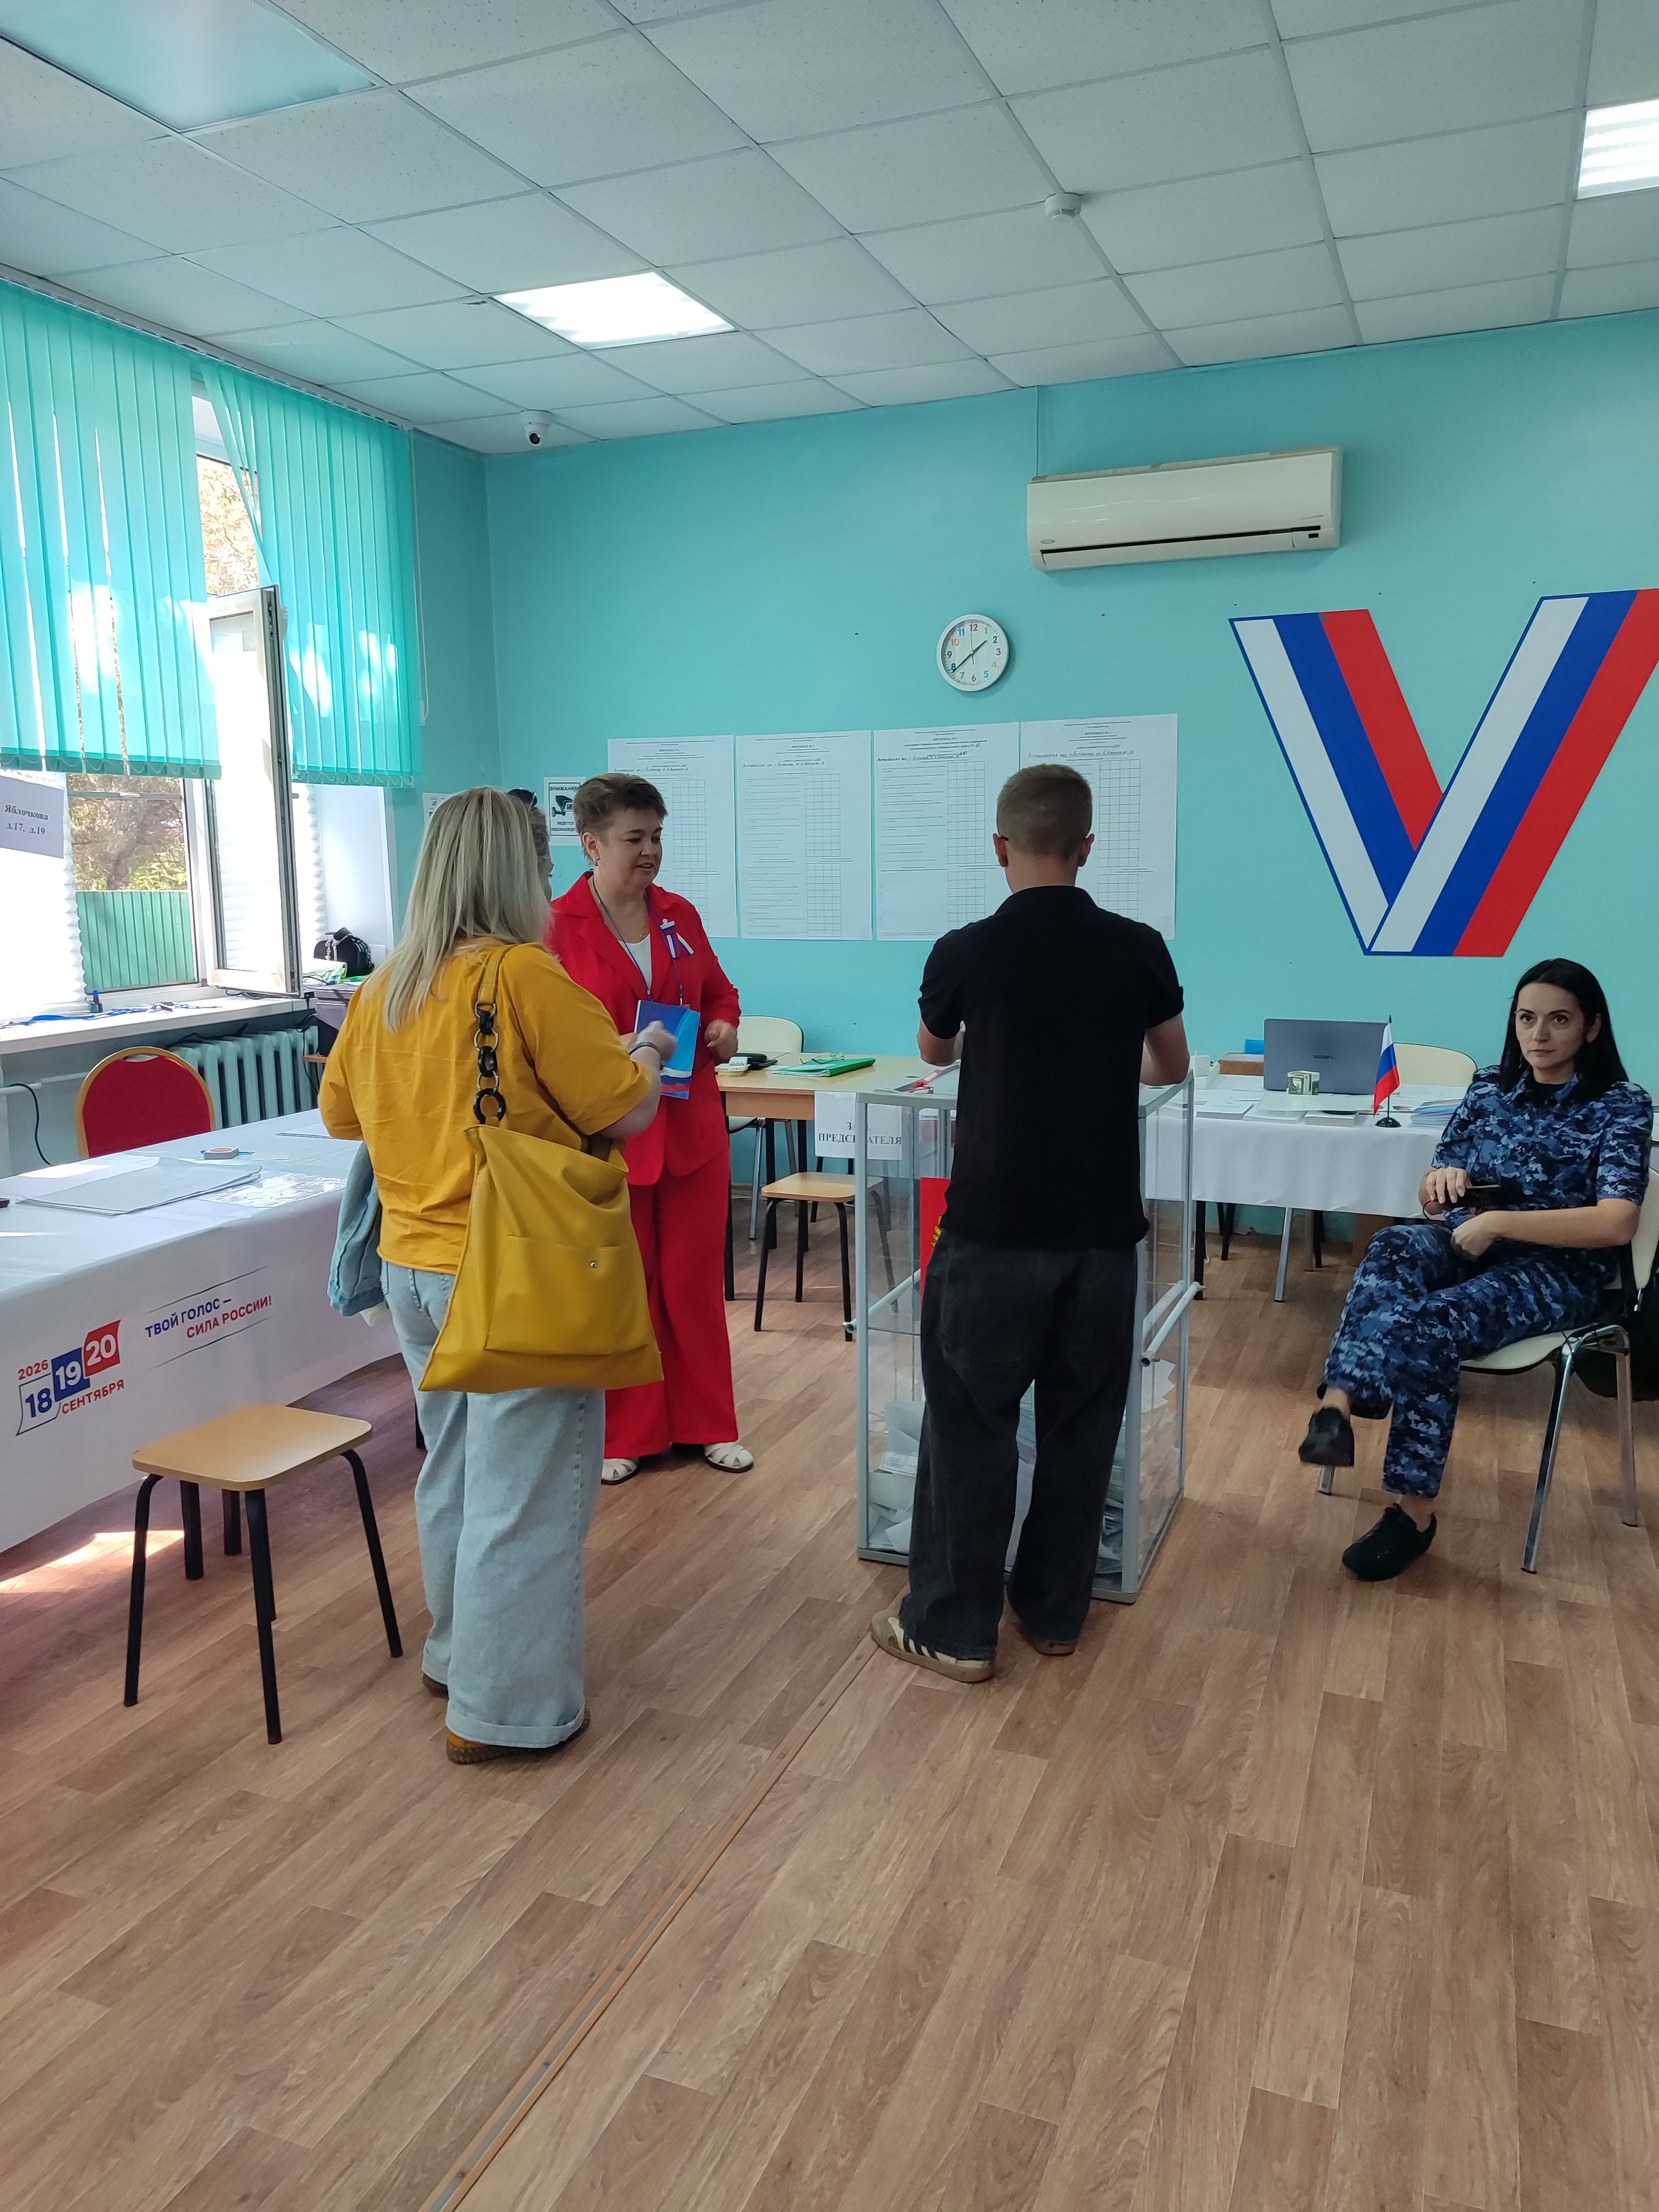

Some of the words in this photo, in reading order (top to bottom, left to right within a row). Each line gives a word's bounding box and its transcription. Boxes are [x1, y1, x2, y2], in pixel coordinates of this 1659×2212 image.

[969, 623, 978, 632] 12
[947, 650, 952, 659] 9
[996, 648, 1001, 656] 3
[972, 674, 977, 682] 6
[4, 804, 48, 821] Яблочкова
[6, 822, 25, 833] д.17,
[29, 826, 45, 835] д.19
[818, 1133, 902, 1145] ПРЕДСАТЕЛЯ
[145, 1312, 179, 1338] ТВОЙ
[181, 1298, 220, 1323] ГОЛОС
[187, 1317, 220, 1338] СИЛА
[222, 1295, 272, 1324] РОССИИ!
[18, 1359, 49, 1380] 2026
[25, 1387, 52, 1418] 18
[55, 1360, 81, 1391] 19
[85, 1334, 117, 1367] 20
[62, 1379, 124, 1415] СЕНТЯБРЯ
